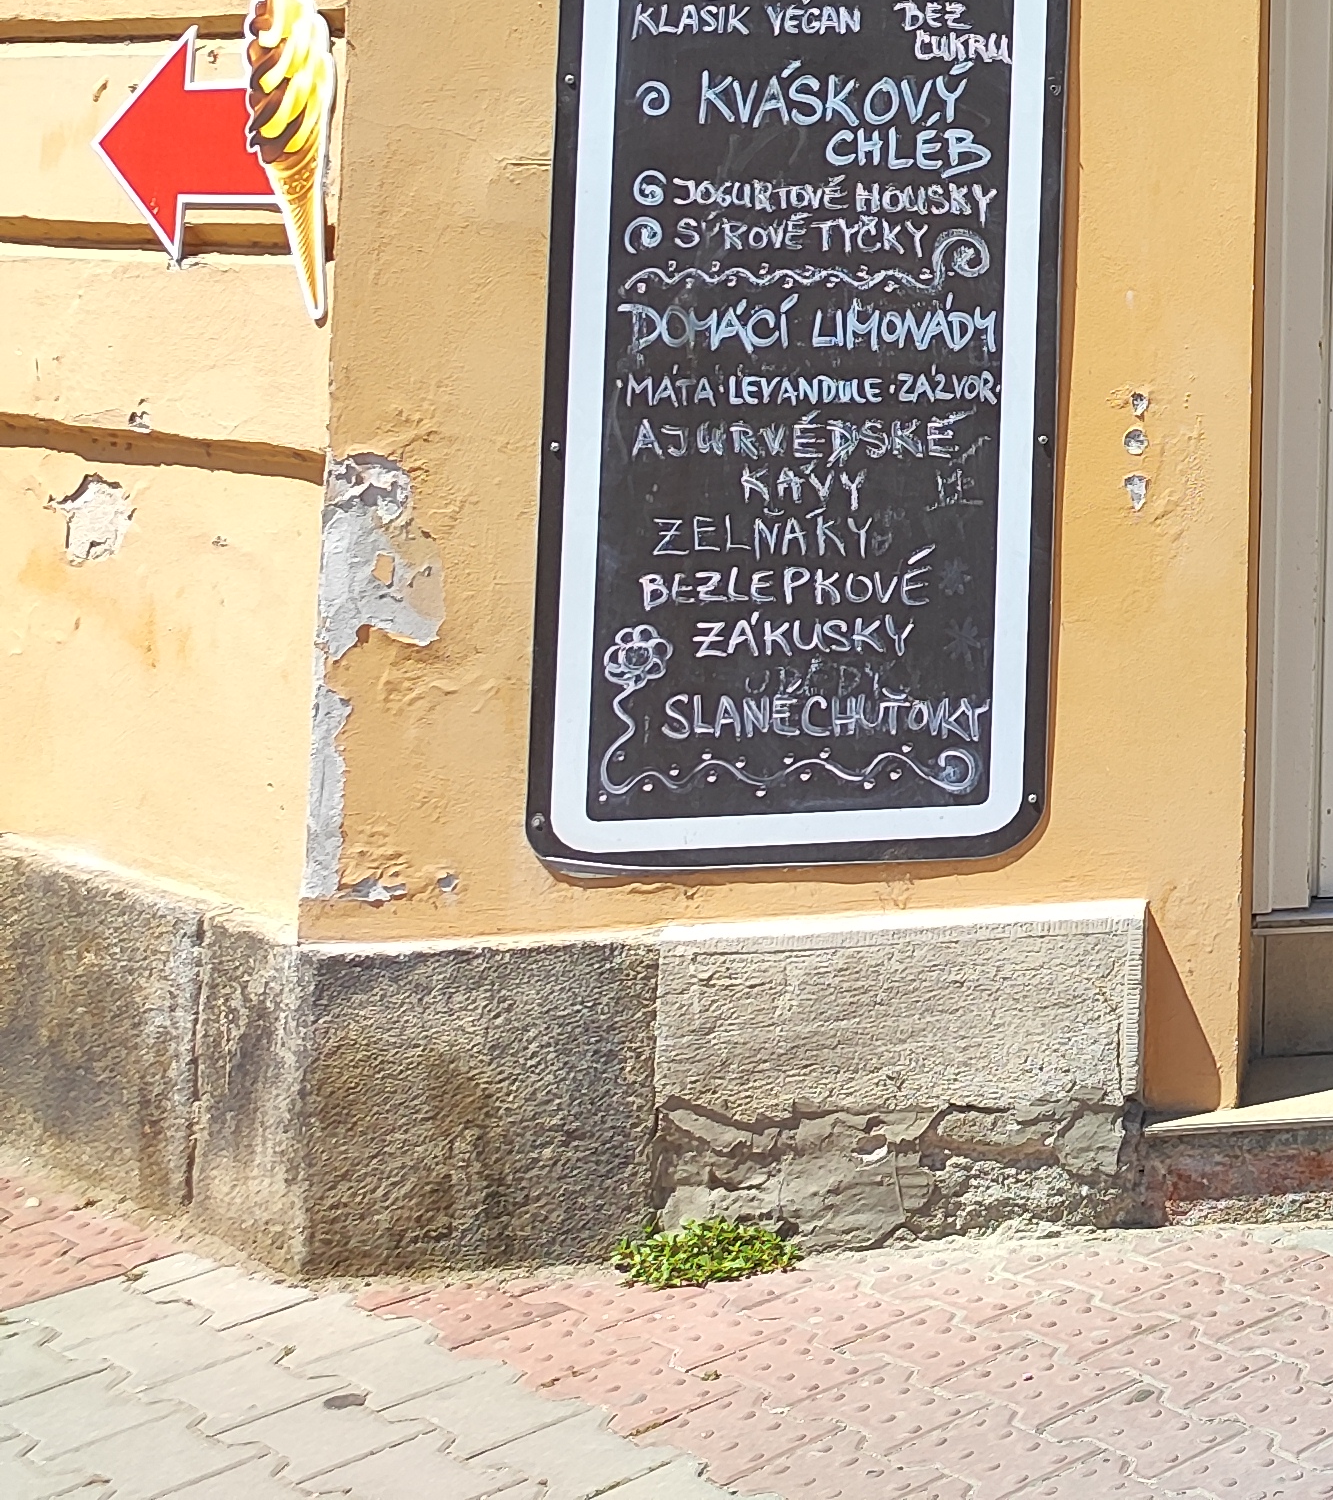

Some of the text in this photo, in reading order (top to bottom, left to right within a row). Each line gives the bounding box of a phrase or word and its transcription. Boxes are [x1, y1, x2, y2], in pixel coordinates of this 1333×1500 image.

[632, 0, 973, 39] KLASIK VEGAN BEZ
[914, 33, 1013, 64] CUKRU
[697, 60, 975, 127] KVÁSKOVÝ
[825, 111, 993, 179] CHLÉB
[673, 174, 998, 228] JOGURTOVÉ HOUSKY
[812, 215, 929, 258] TYČKY
[617, 292, 999, 354] DOMÁCÍ LIMONÁDY
[626, 363, 998, 407] MÁTA LEVANDULE ZÁZVOR
[631, 405, 977, 466] AJURVÉDSKÉ
[740, 459, 869, 511] KÁVY
[652, 506, 873, 560] ZELŇÁKY
[637, 544, 938, 611] BEZLEPKOVÉ
[693, 611, 915, 658] ZÁKUSKY
